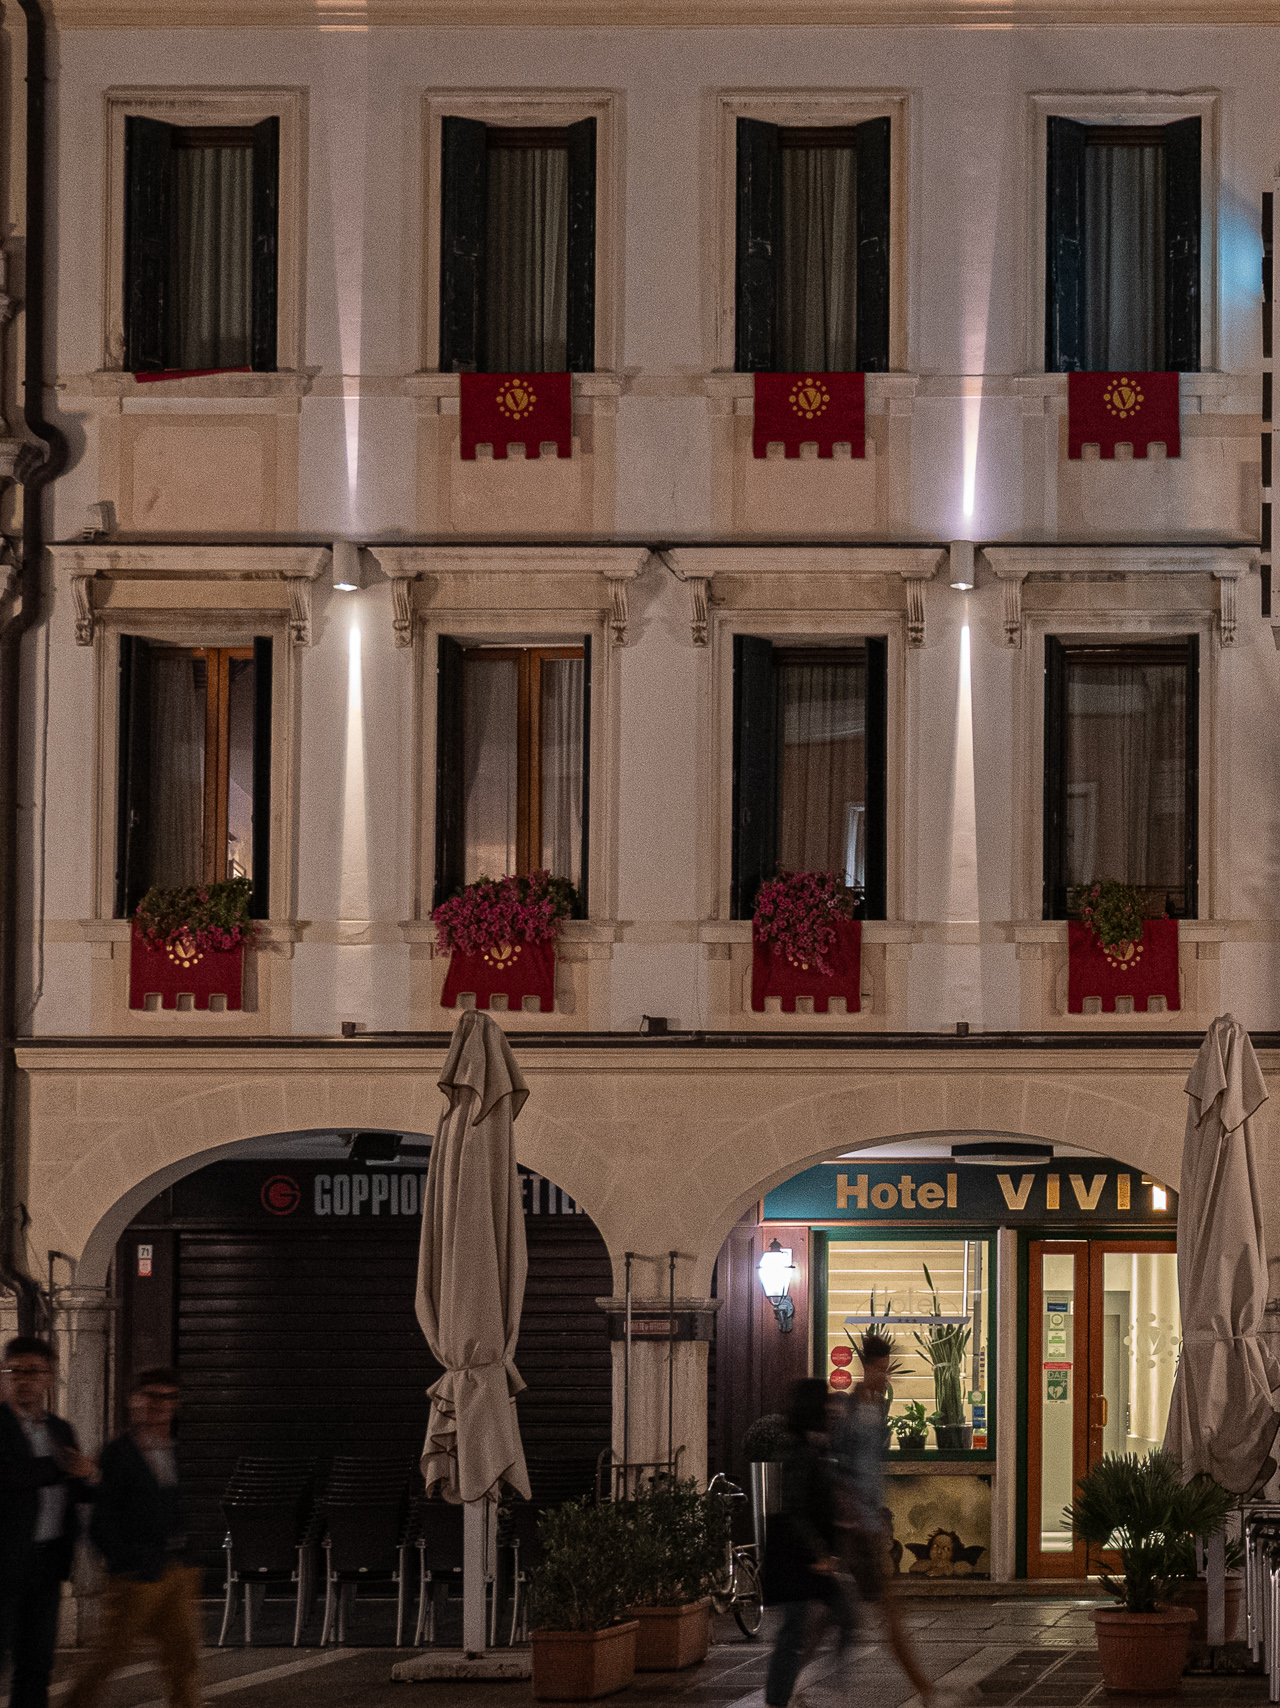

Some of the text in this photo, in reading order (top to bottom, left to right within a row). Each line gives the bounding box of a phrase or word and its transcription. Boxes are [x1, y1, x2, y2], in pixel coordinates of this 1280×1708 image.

[836, 1173, 957, 1209] Hotel
[141, 1247, 150, 1257] 71
[1047, 1371, 1068, 1379] DAE
